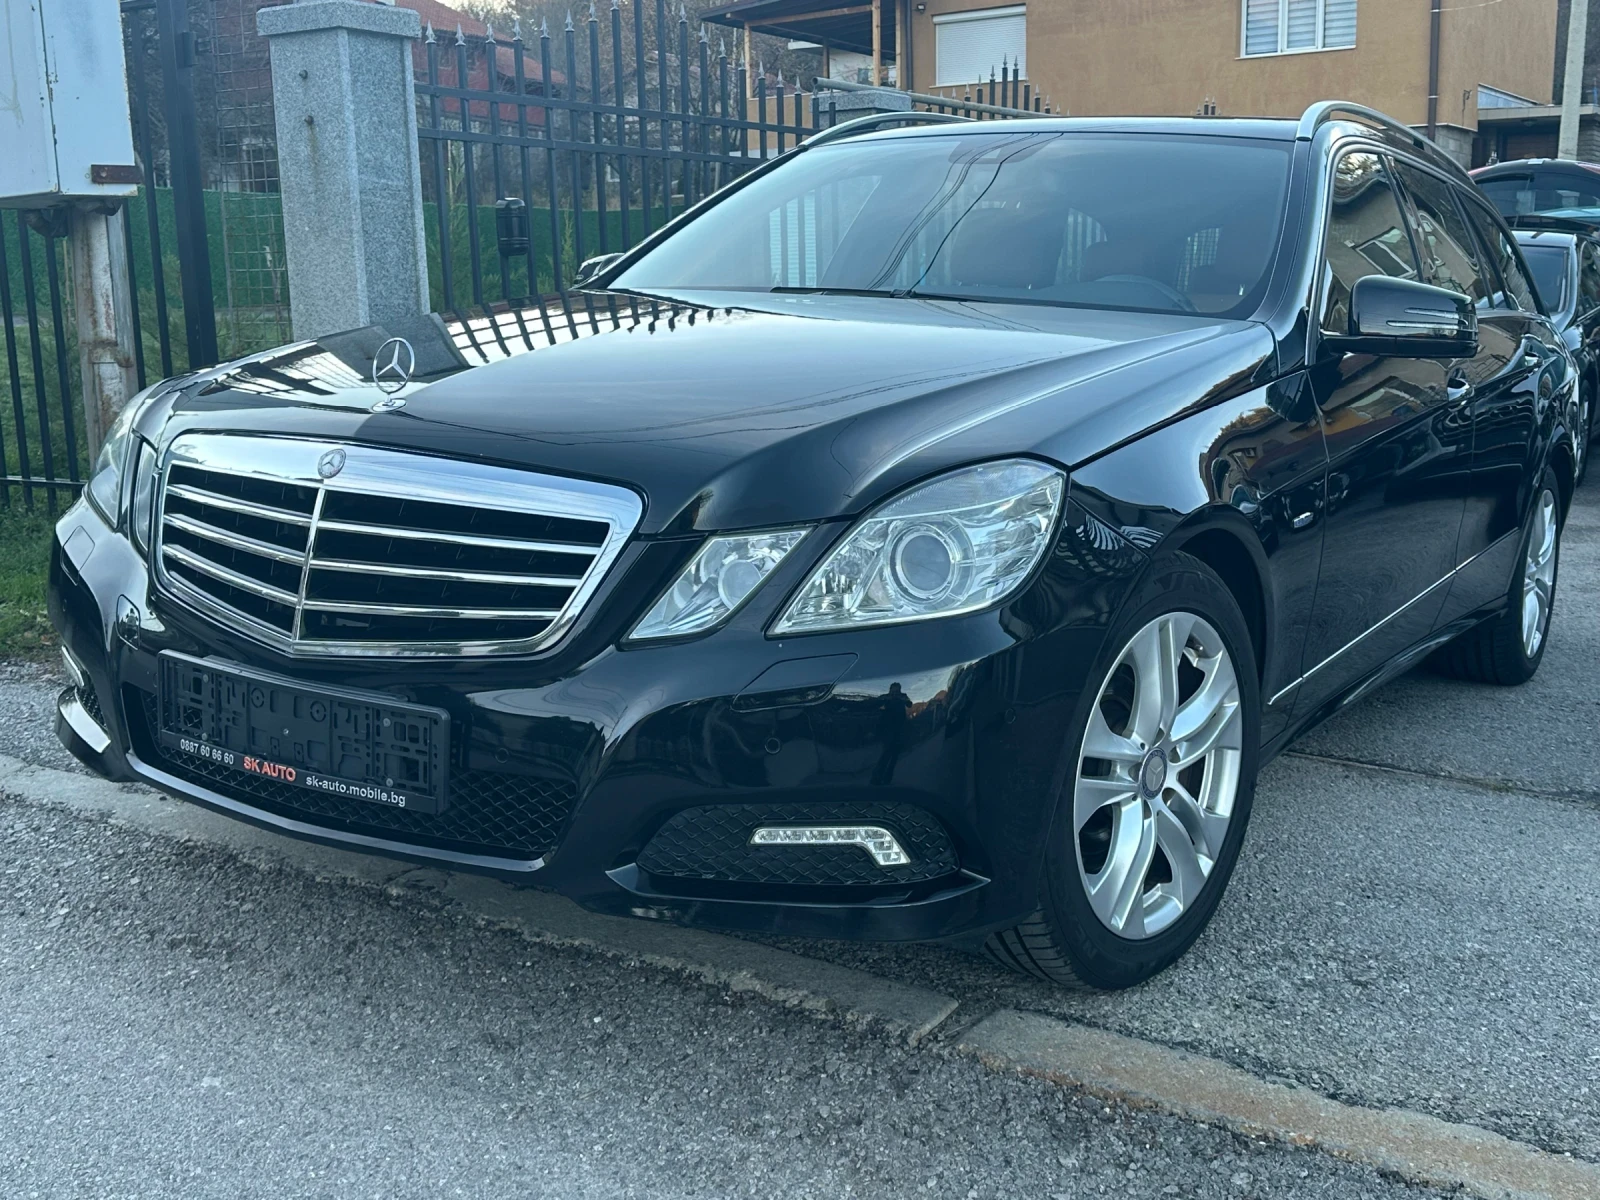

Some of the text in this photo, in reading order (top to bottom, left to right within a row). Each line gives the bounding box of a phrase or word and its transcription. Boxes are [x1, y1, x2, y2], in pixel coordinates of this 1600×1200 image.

[180, 739, 234, 765] 0887 60 66 60
[243, 756, 296, 782] SK AUTO
[305, 775, 406, 807] sk-auto.mobile.bg
